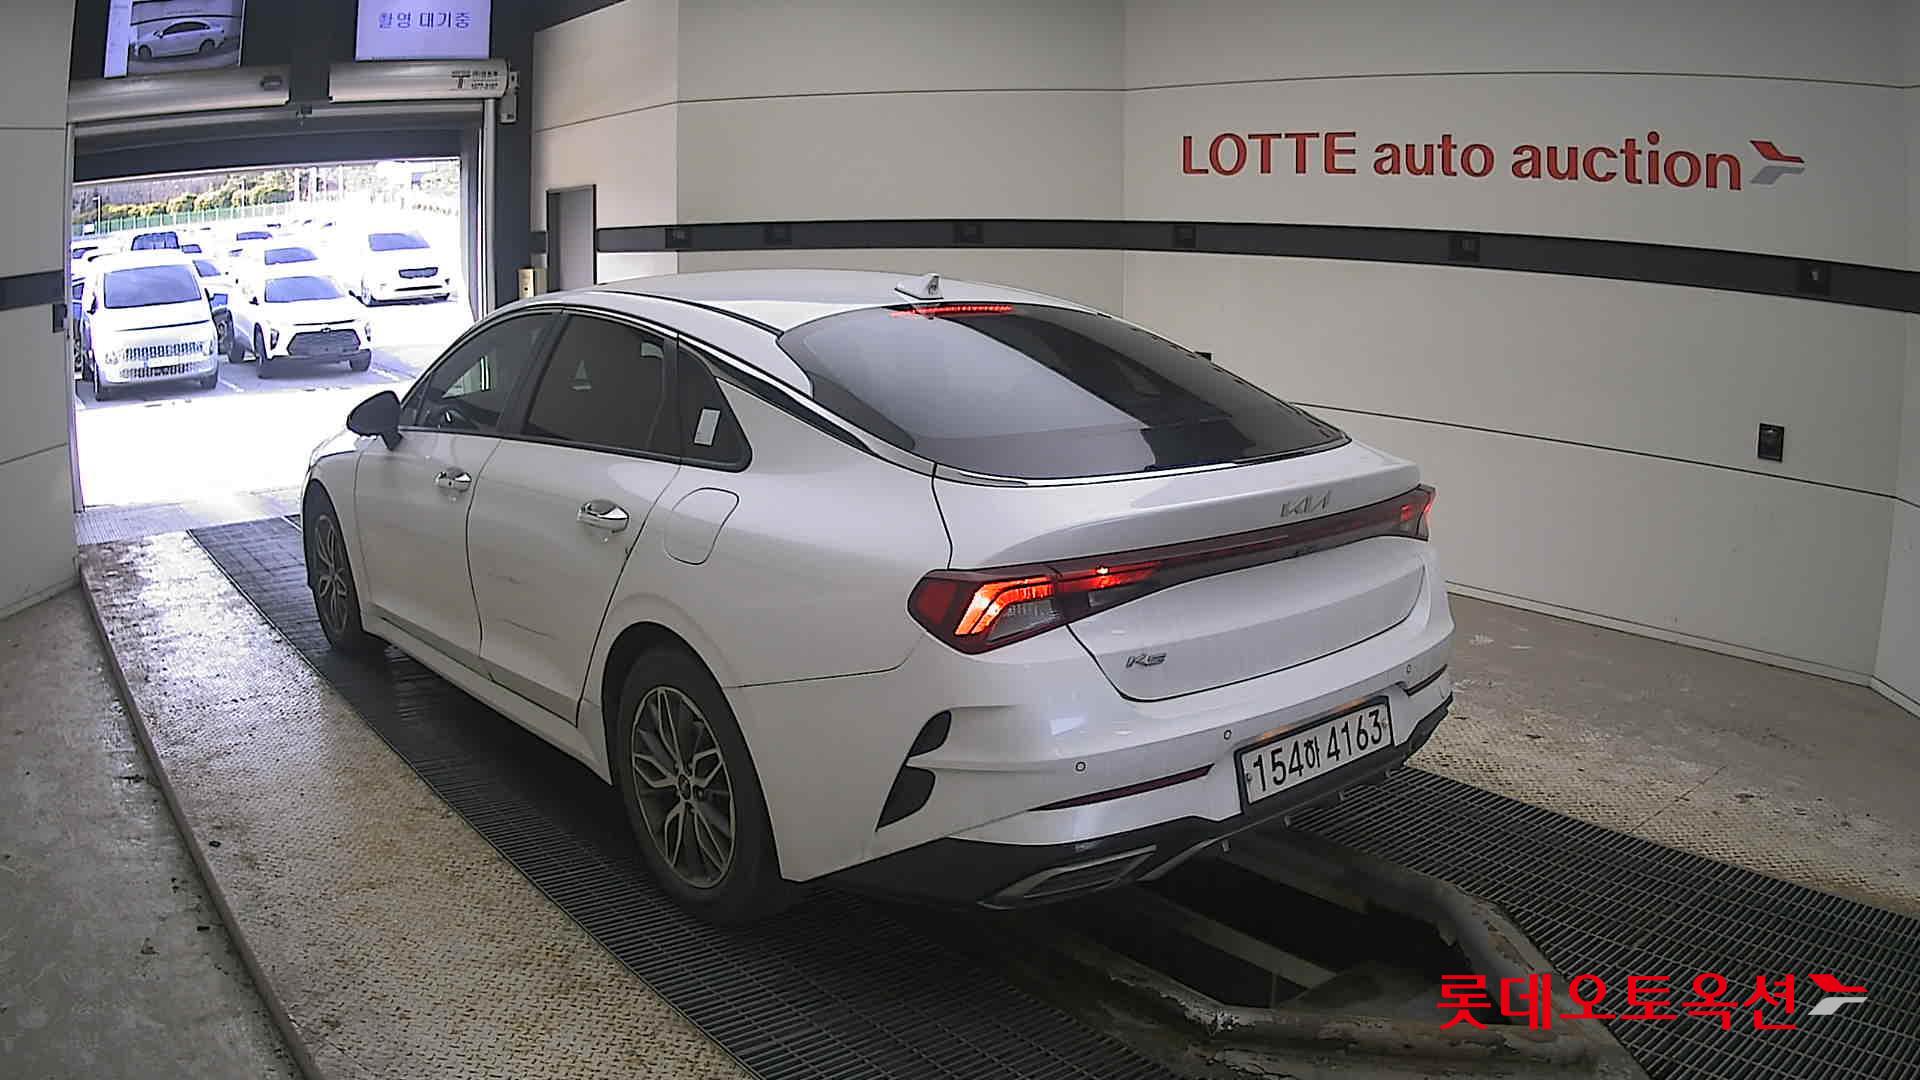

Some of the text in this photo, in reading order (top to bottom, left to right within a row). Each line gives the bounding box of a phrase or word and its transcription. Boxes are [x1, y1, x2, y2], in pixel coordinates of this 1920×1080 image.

[419, 11, 473, 29] 대기중
[1181, 130, 1743, 192] LOTTE auto auction
[1280, 490, 1332, 519] KIA
[1125, 651, 1167, 668] K5
[1252, 708, 1383, 792] 154하 4163
